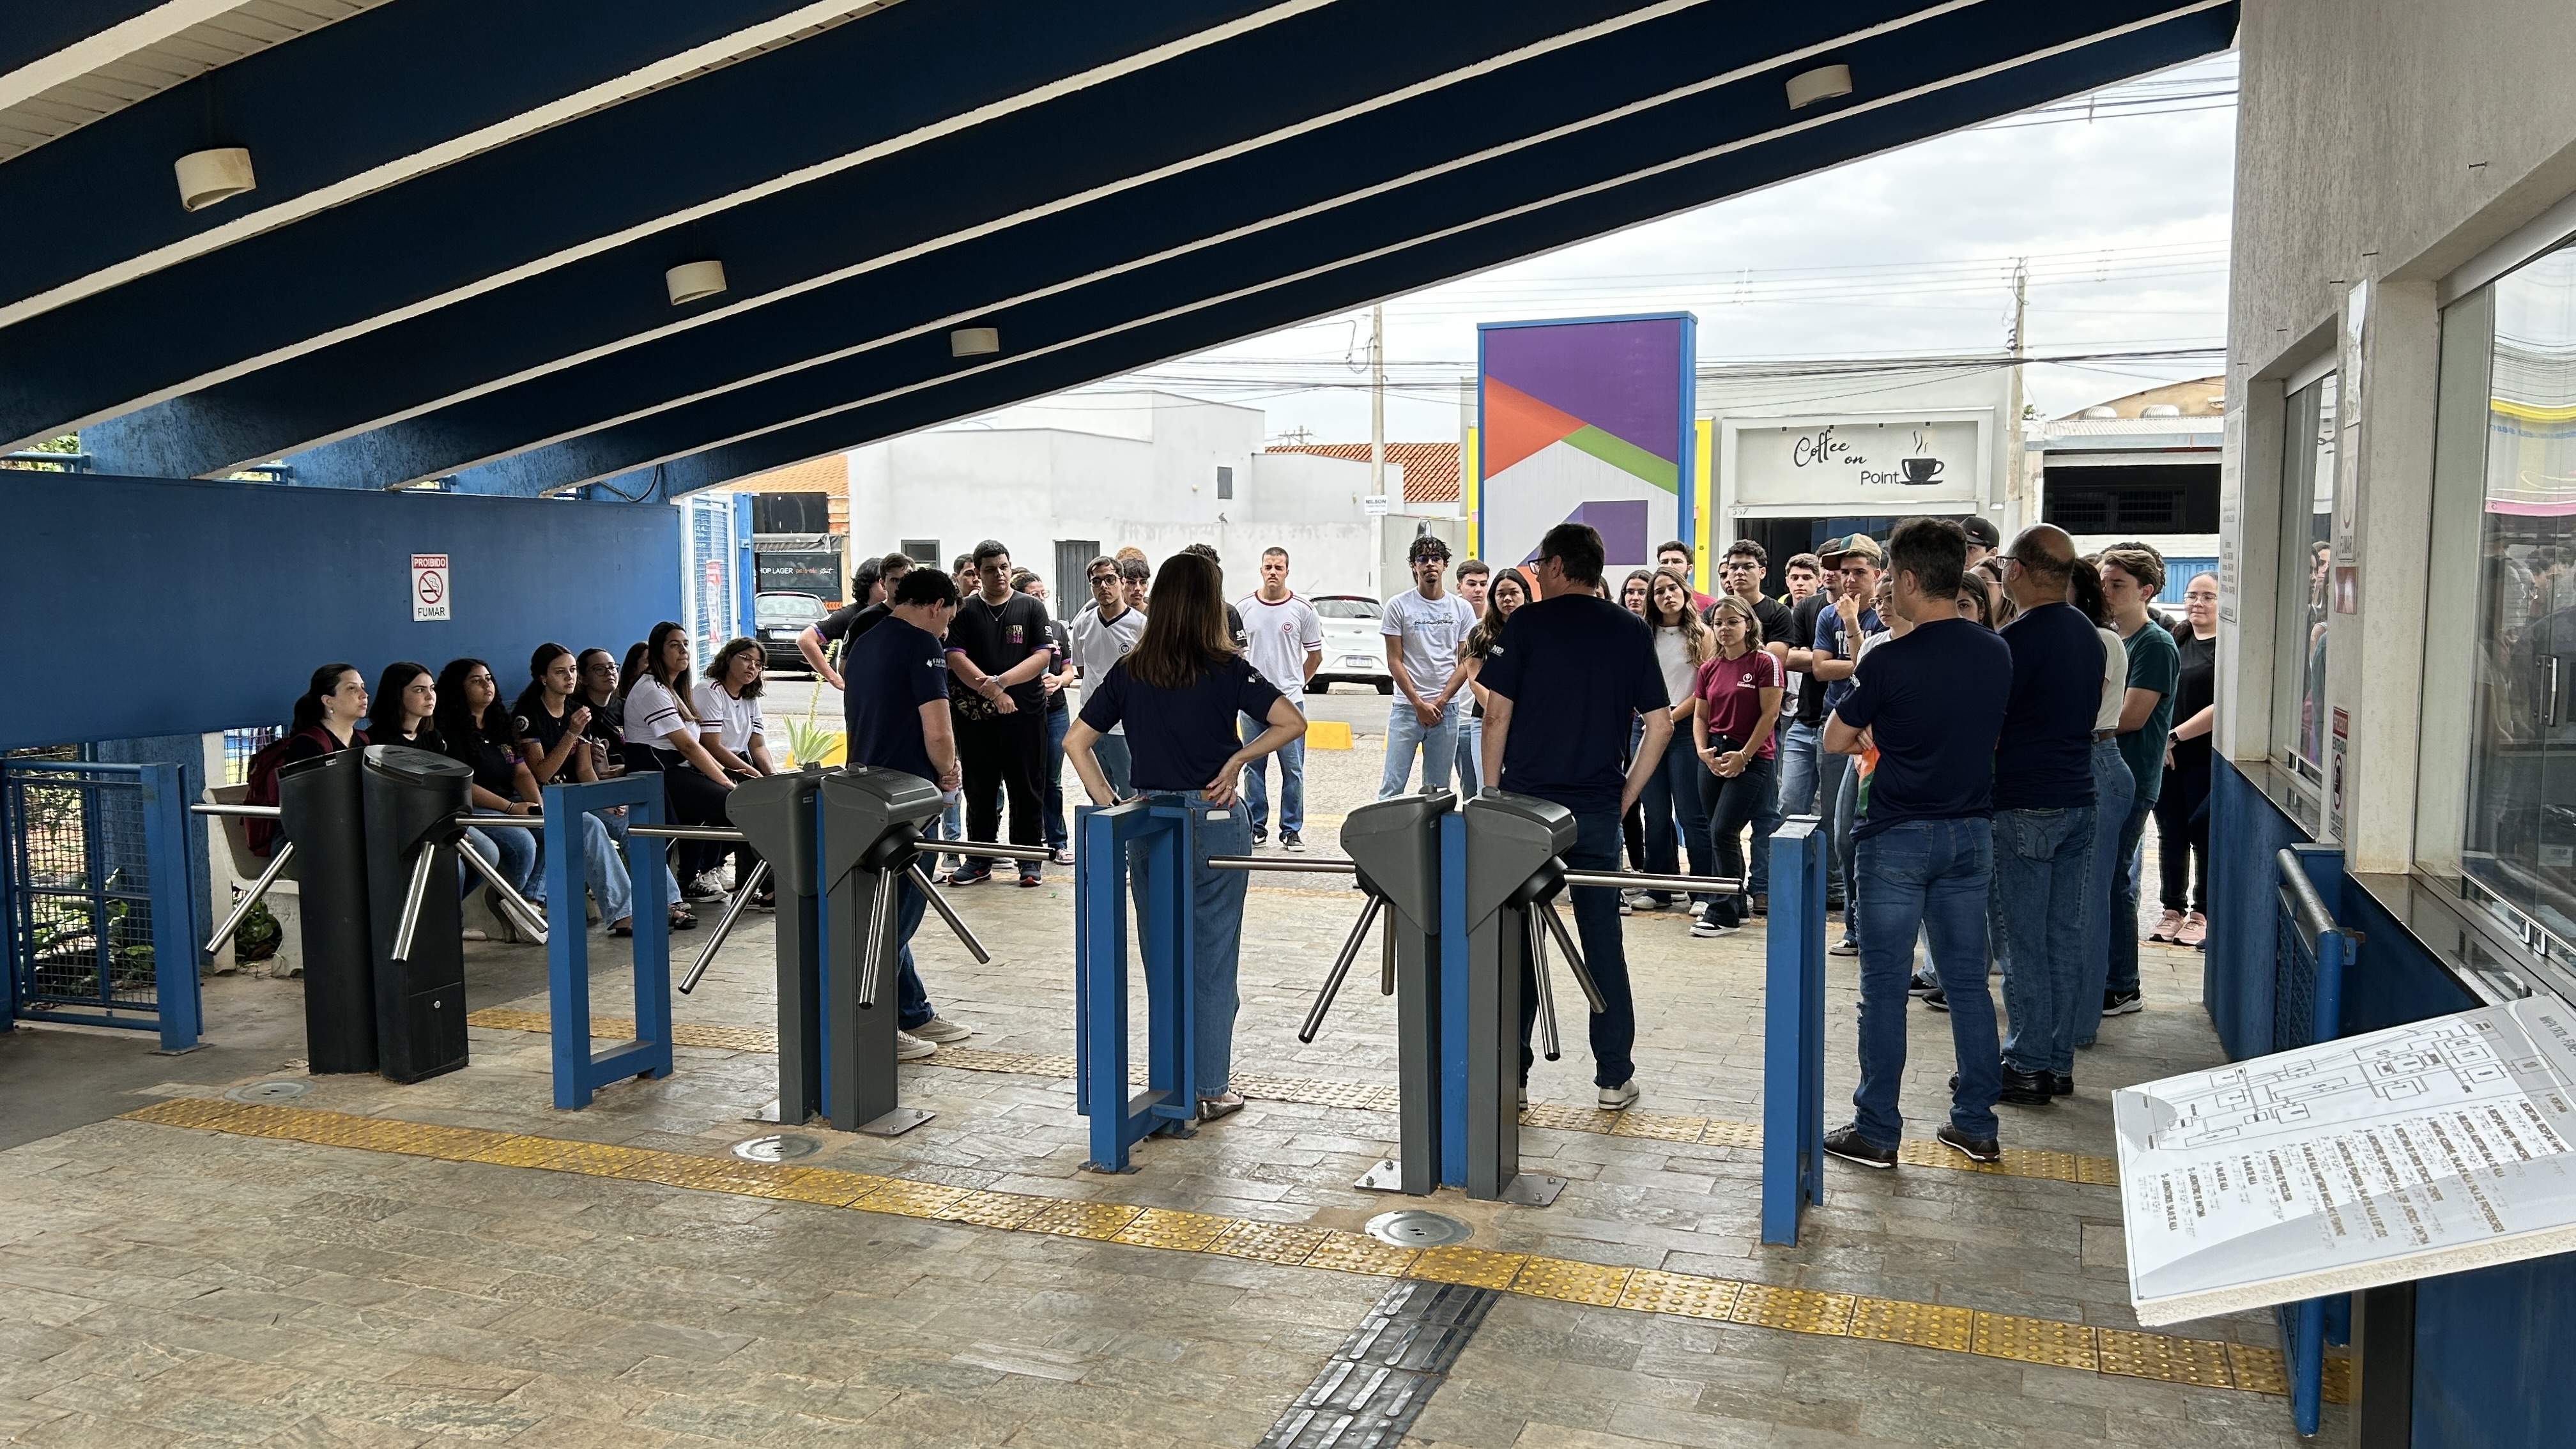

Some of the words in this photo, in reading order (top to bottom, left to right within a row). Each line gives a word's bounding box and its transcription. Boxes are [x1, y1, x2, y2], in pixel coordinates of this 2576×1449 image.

[1793, 429, 1850, 467] Coffee
[1844, 456, 1867, 464] on
[1861, 470, 1899, 485] Point
[414, 558, 445, 567] PROIBIDO
[418, 606, 445, 617] FUMAR
